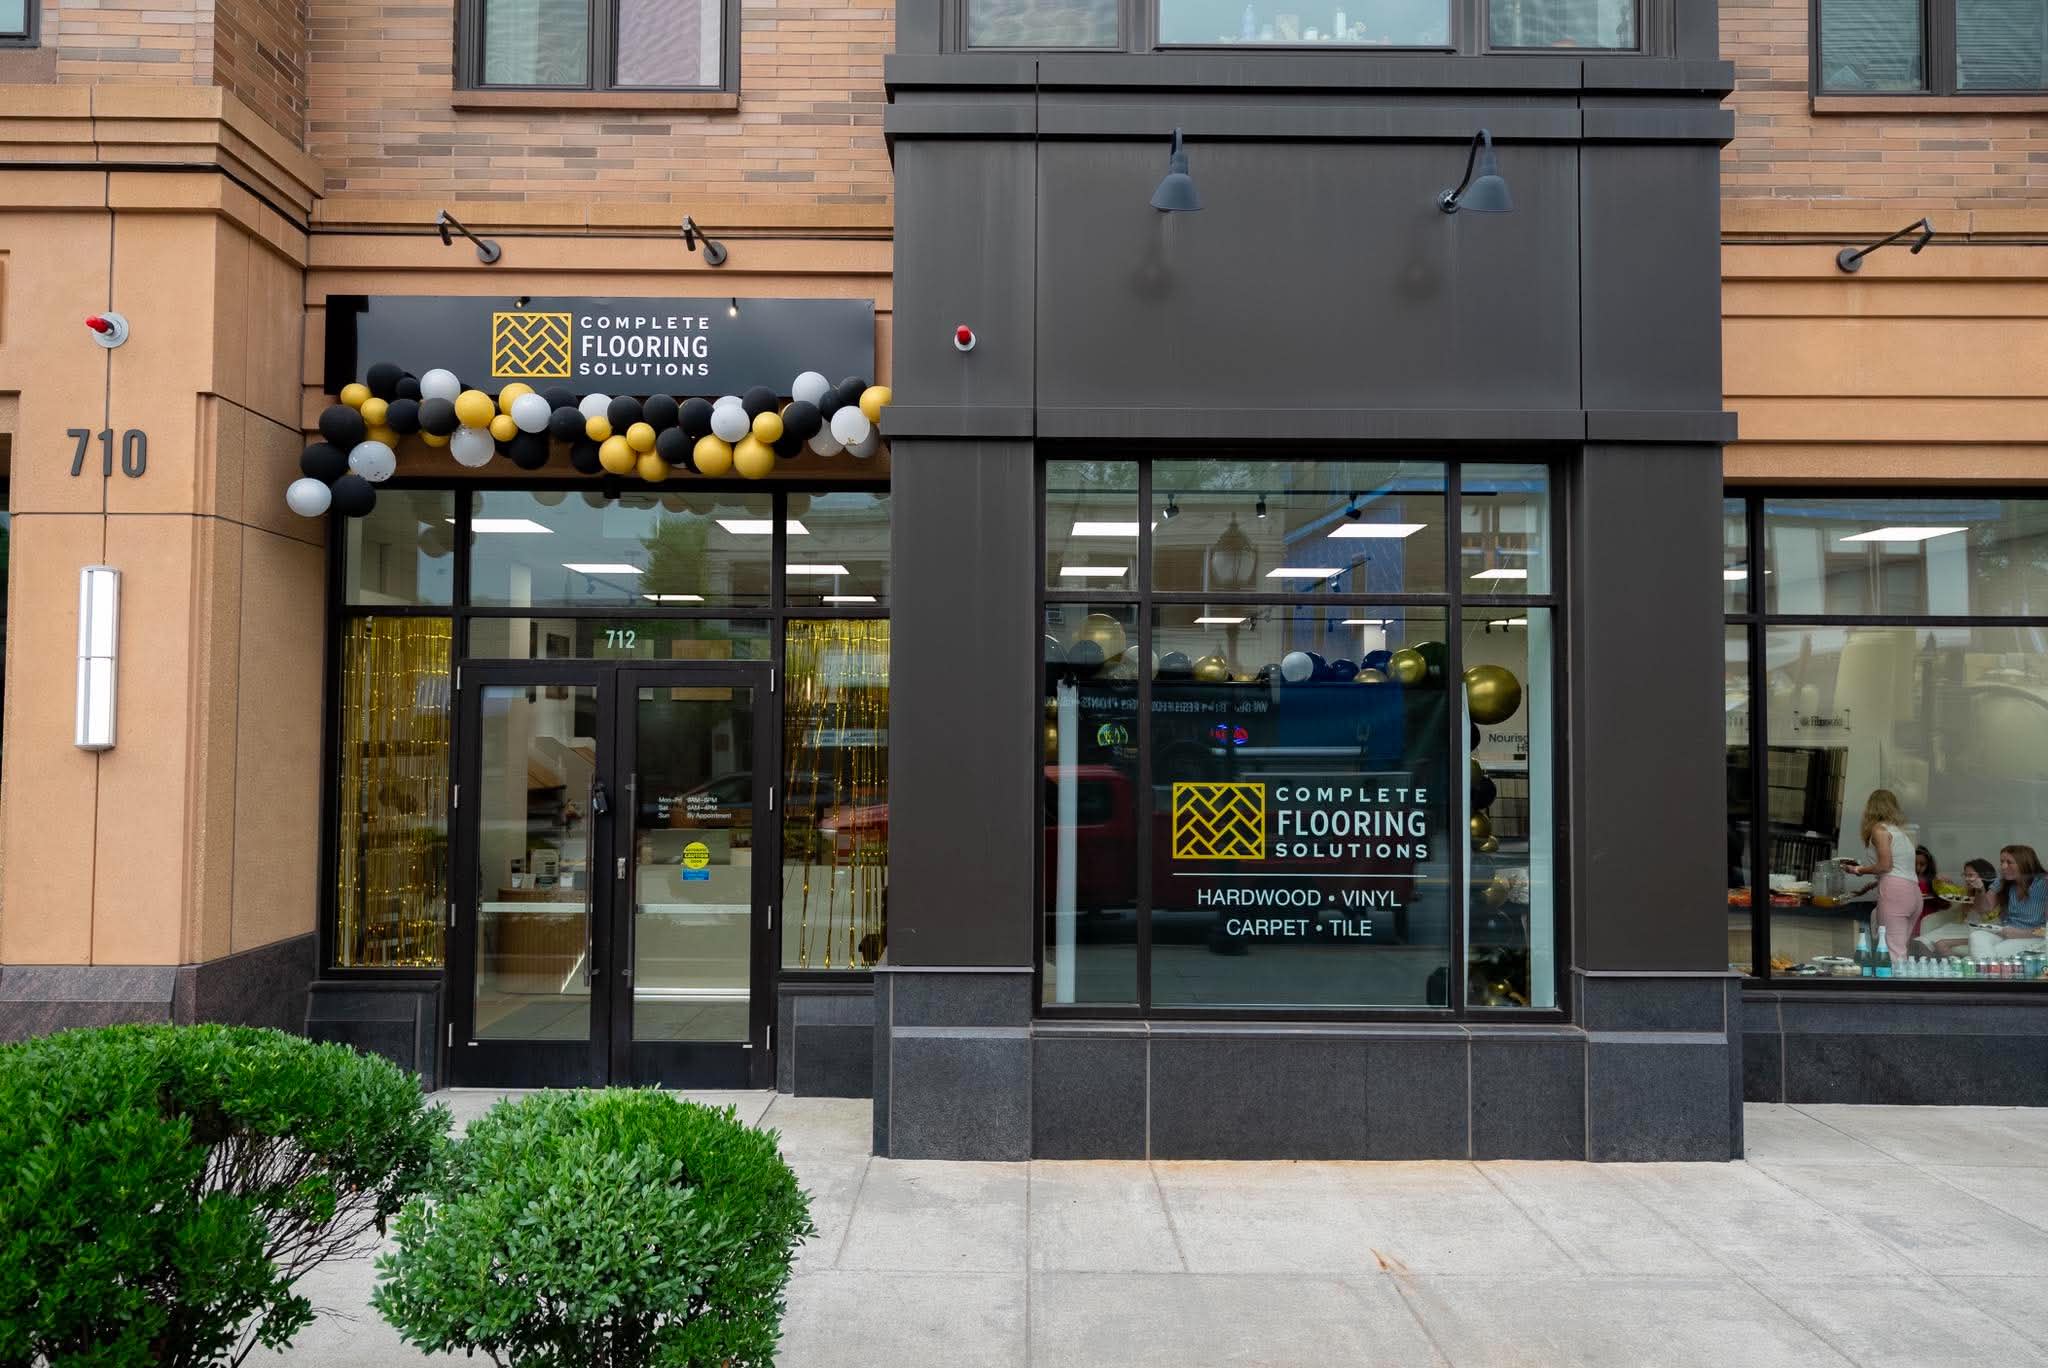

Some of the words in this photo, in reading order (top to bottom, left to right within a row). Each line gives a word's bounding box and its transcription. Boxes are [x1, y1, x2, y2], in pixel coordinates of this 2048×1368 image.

[580, 316, 709, 329] COMPLETE
[582, 335, 708, 358] FLOORING
[579, 363, 709, 376] SOLUTIONS
[67, 429, 147, 478] 710
[606, 630, 635, 648] 712
[1275, 787, 1427, 803] COMPLETE
[695, 812, 732, 820] Appointment
[1277, 810, 1426, 837] FLOORING
[1275, 843, 1428, 859] SOLUTIONS
[1197, 888, 1322, 907] HARDWOOD
[1342, 889, 1402, 907] VINYL
[1226, 918, 1310, 936] CARPET
[1329, 919, 1373, 937] TILE
